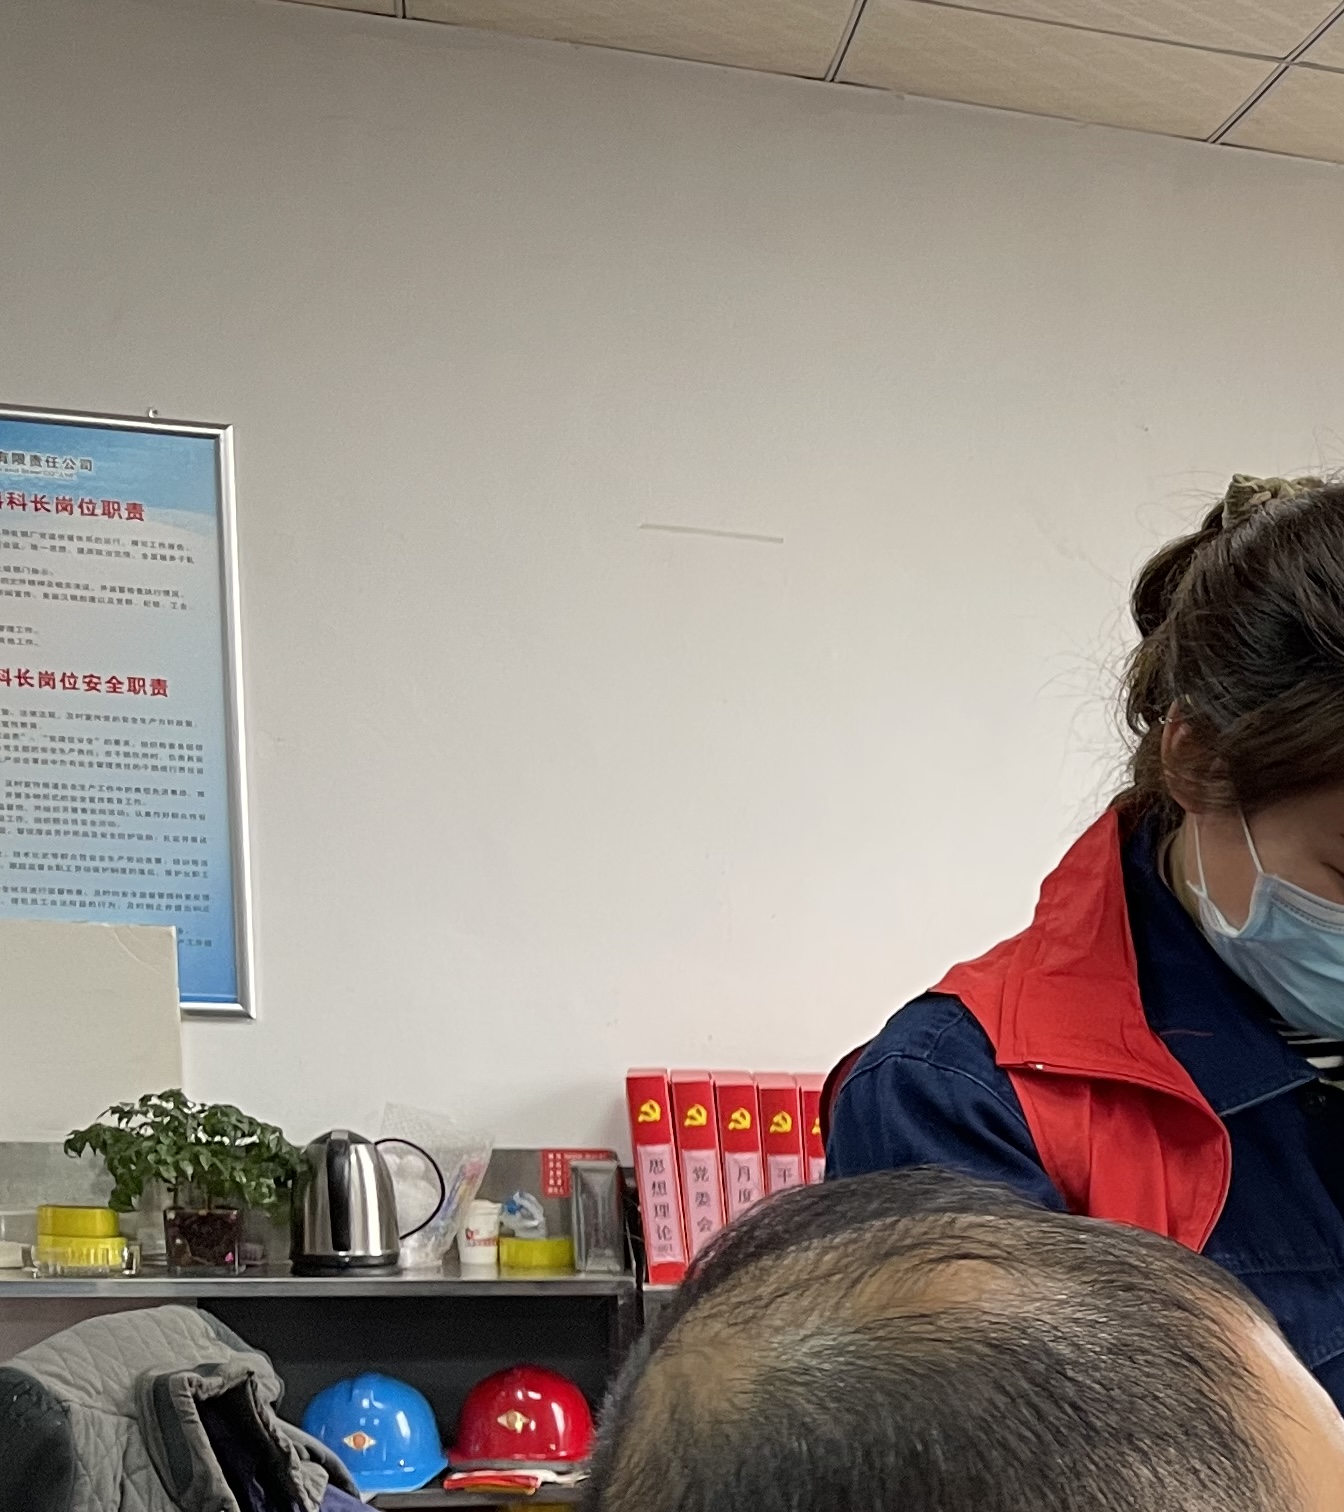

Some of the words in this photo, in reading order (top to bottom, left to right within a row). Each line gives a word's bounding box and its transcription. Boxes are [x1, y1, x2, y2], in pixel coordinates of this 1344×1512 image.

[0, 491, 144, 521] 科长岗位职责
[649, 1160, 673, 1241] 思想理论
